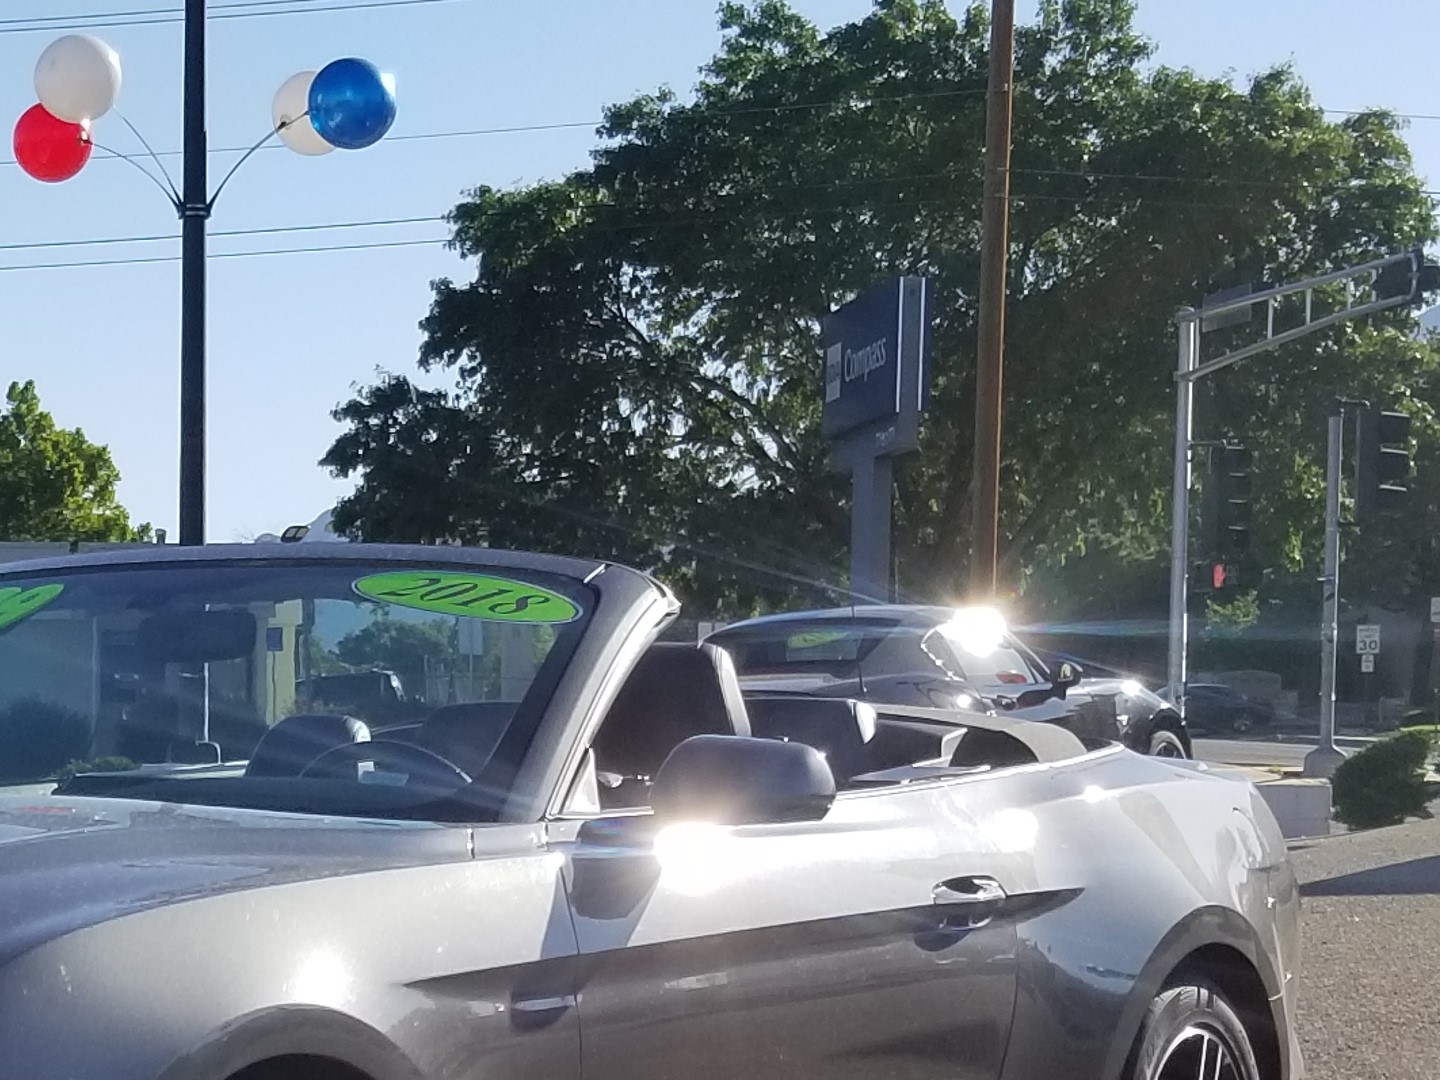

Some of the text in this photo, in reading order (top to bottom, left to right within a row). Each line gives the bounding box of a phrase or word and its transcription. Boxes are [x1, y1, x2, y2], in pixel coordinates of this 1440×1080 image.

[844, 337, 886, 382] Compass
[375, 577, 552, 615] 2018
[1359, 640, 1377, 652] 30
